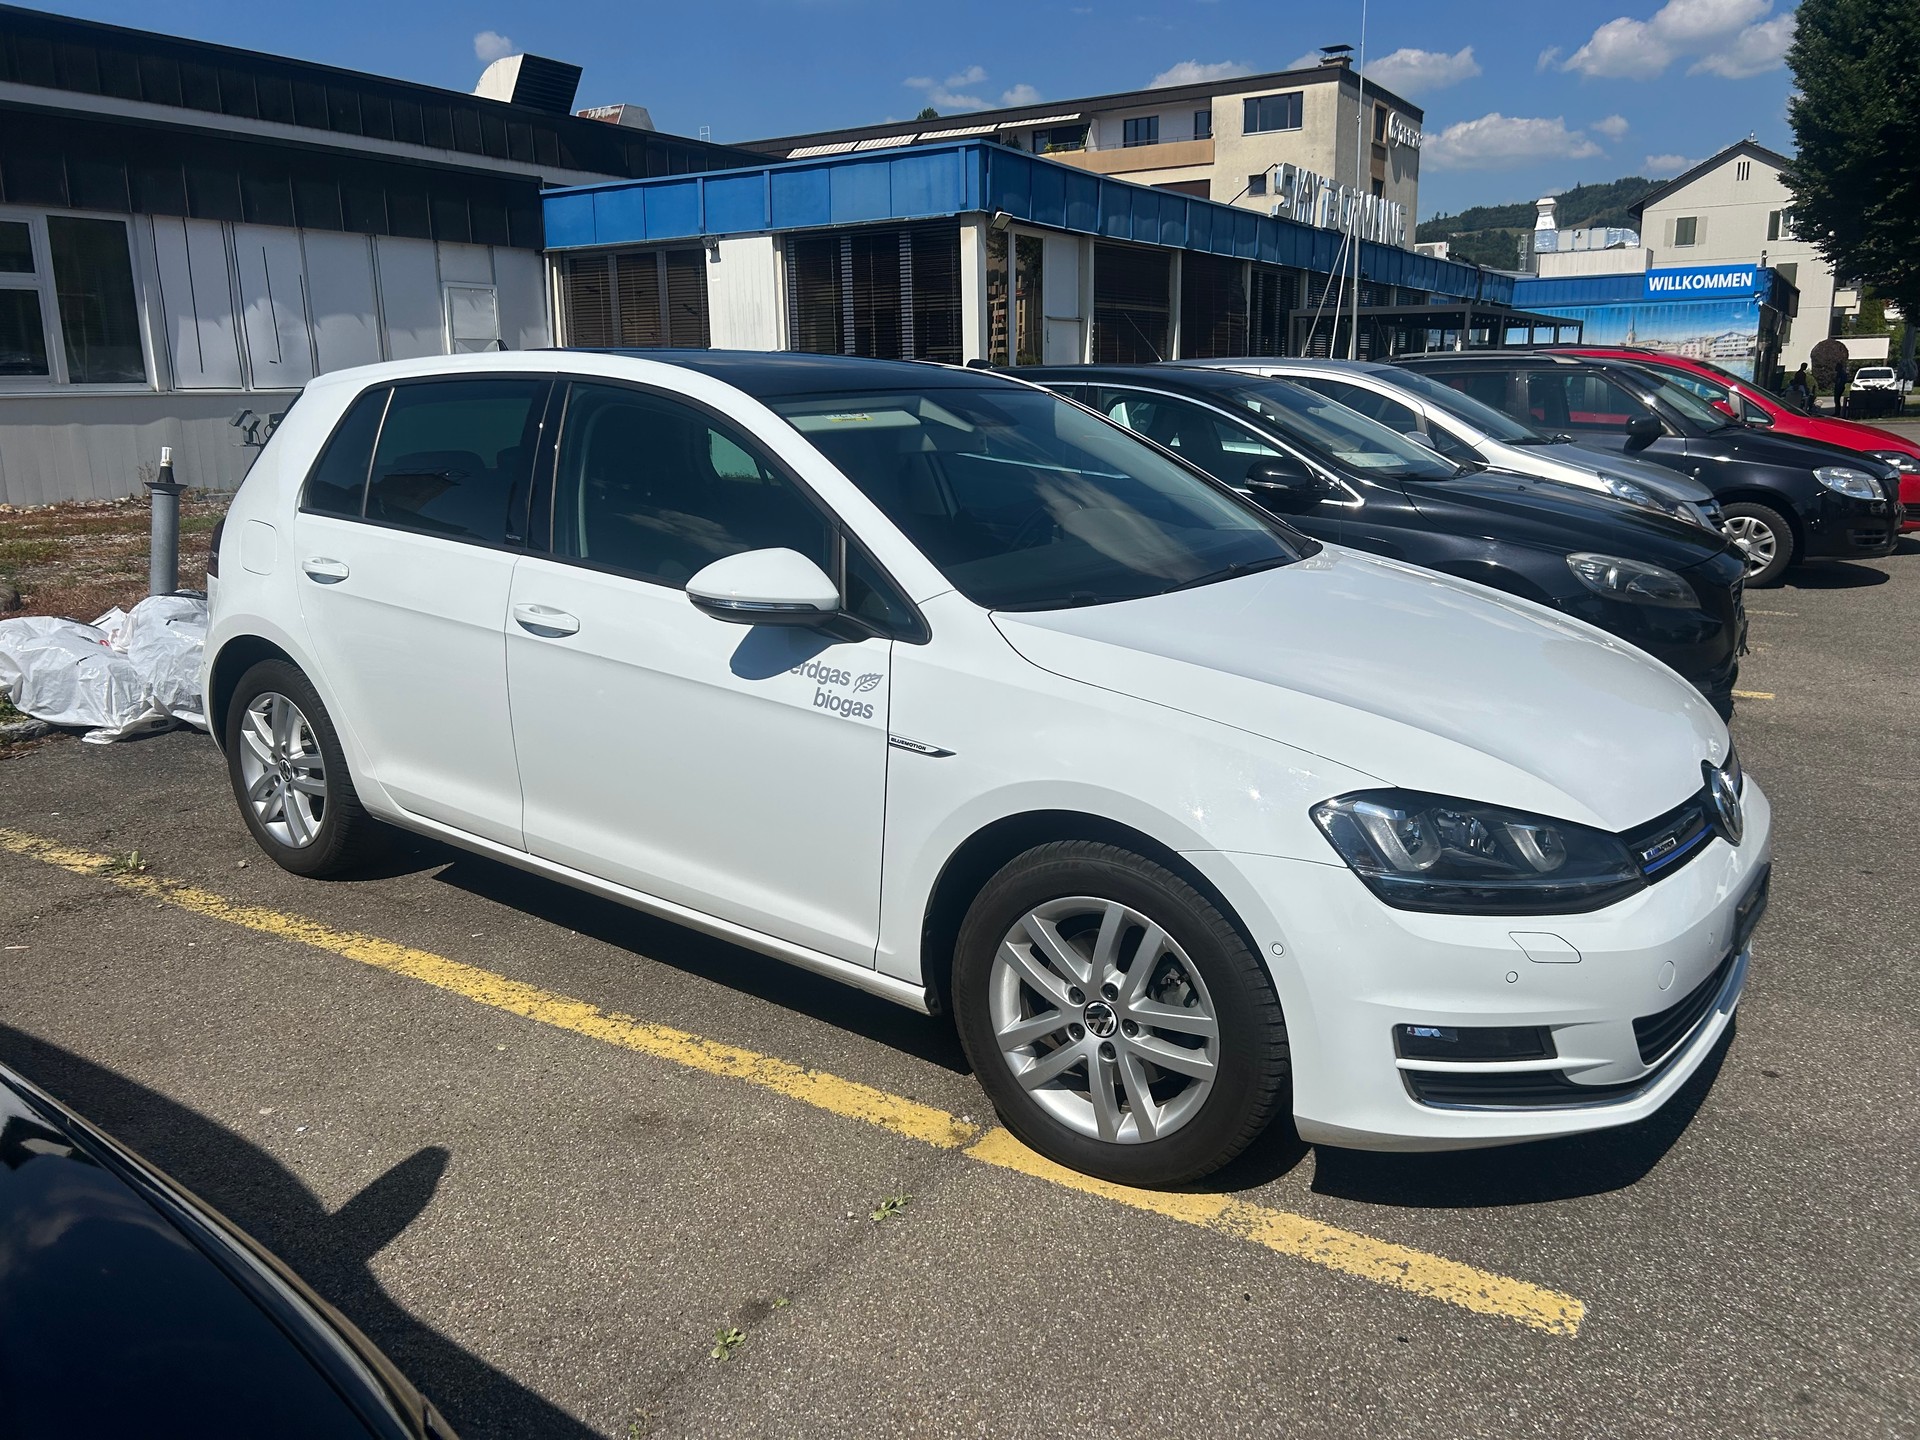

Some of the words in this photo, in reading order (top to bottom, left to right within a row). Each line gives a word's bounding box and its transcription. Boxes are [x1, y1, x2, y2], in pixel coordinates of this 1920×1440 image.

[1650, 272, 1752, 291] WILLKOMMEN
[813, 687, 874, 719] biogas
[890, 737, 927, 751] BLUEMOTION
